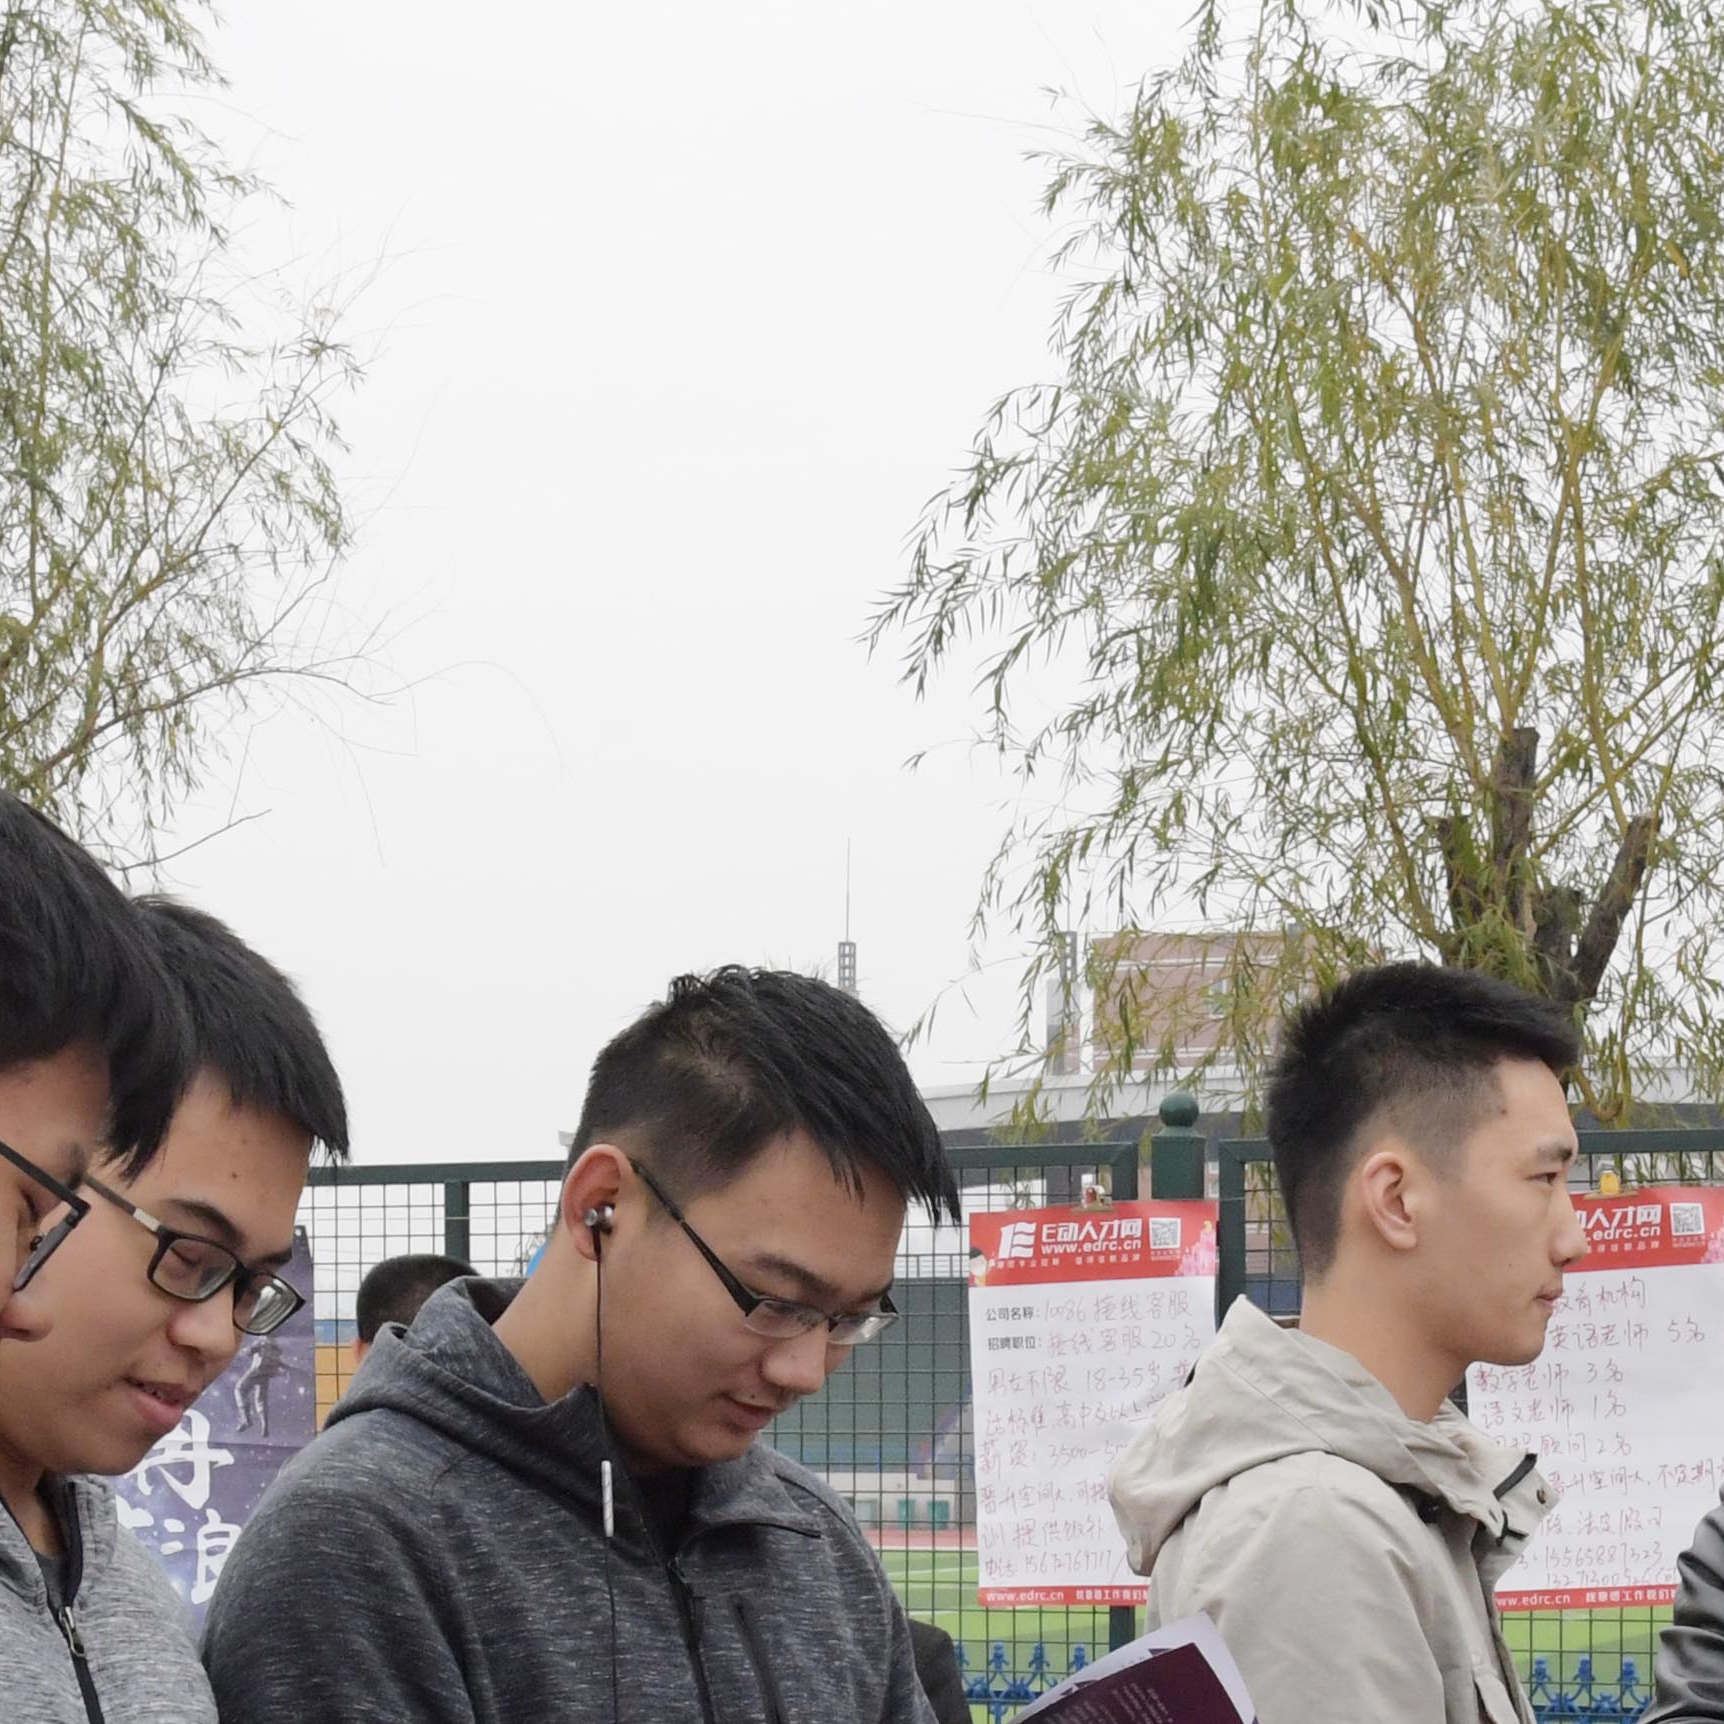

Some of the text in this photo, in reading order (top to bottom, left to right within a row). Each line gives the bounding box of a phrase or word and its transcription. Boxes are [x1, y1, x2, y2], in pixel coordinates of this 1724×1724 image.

[1041, 1218, 1143, 1243] E动人才网
[1041, 1238, 1142, 1254] www.edrc.cn
[986, 1590, 1065, 1602] www.edrc.cn
